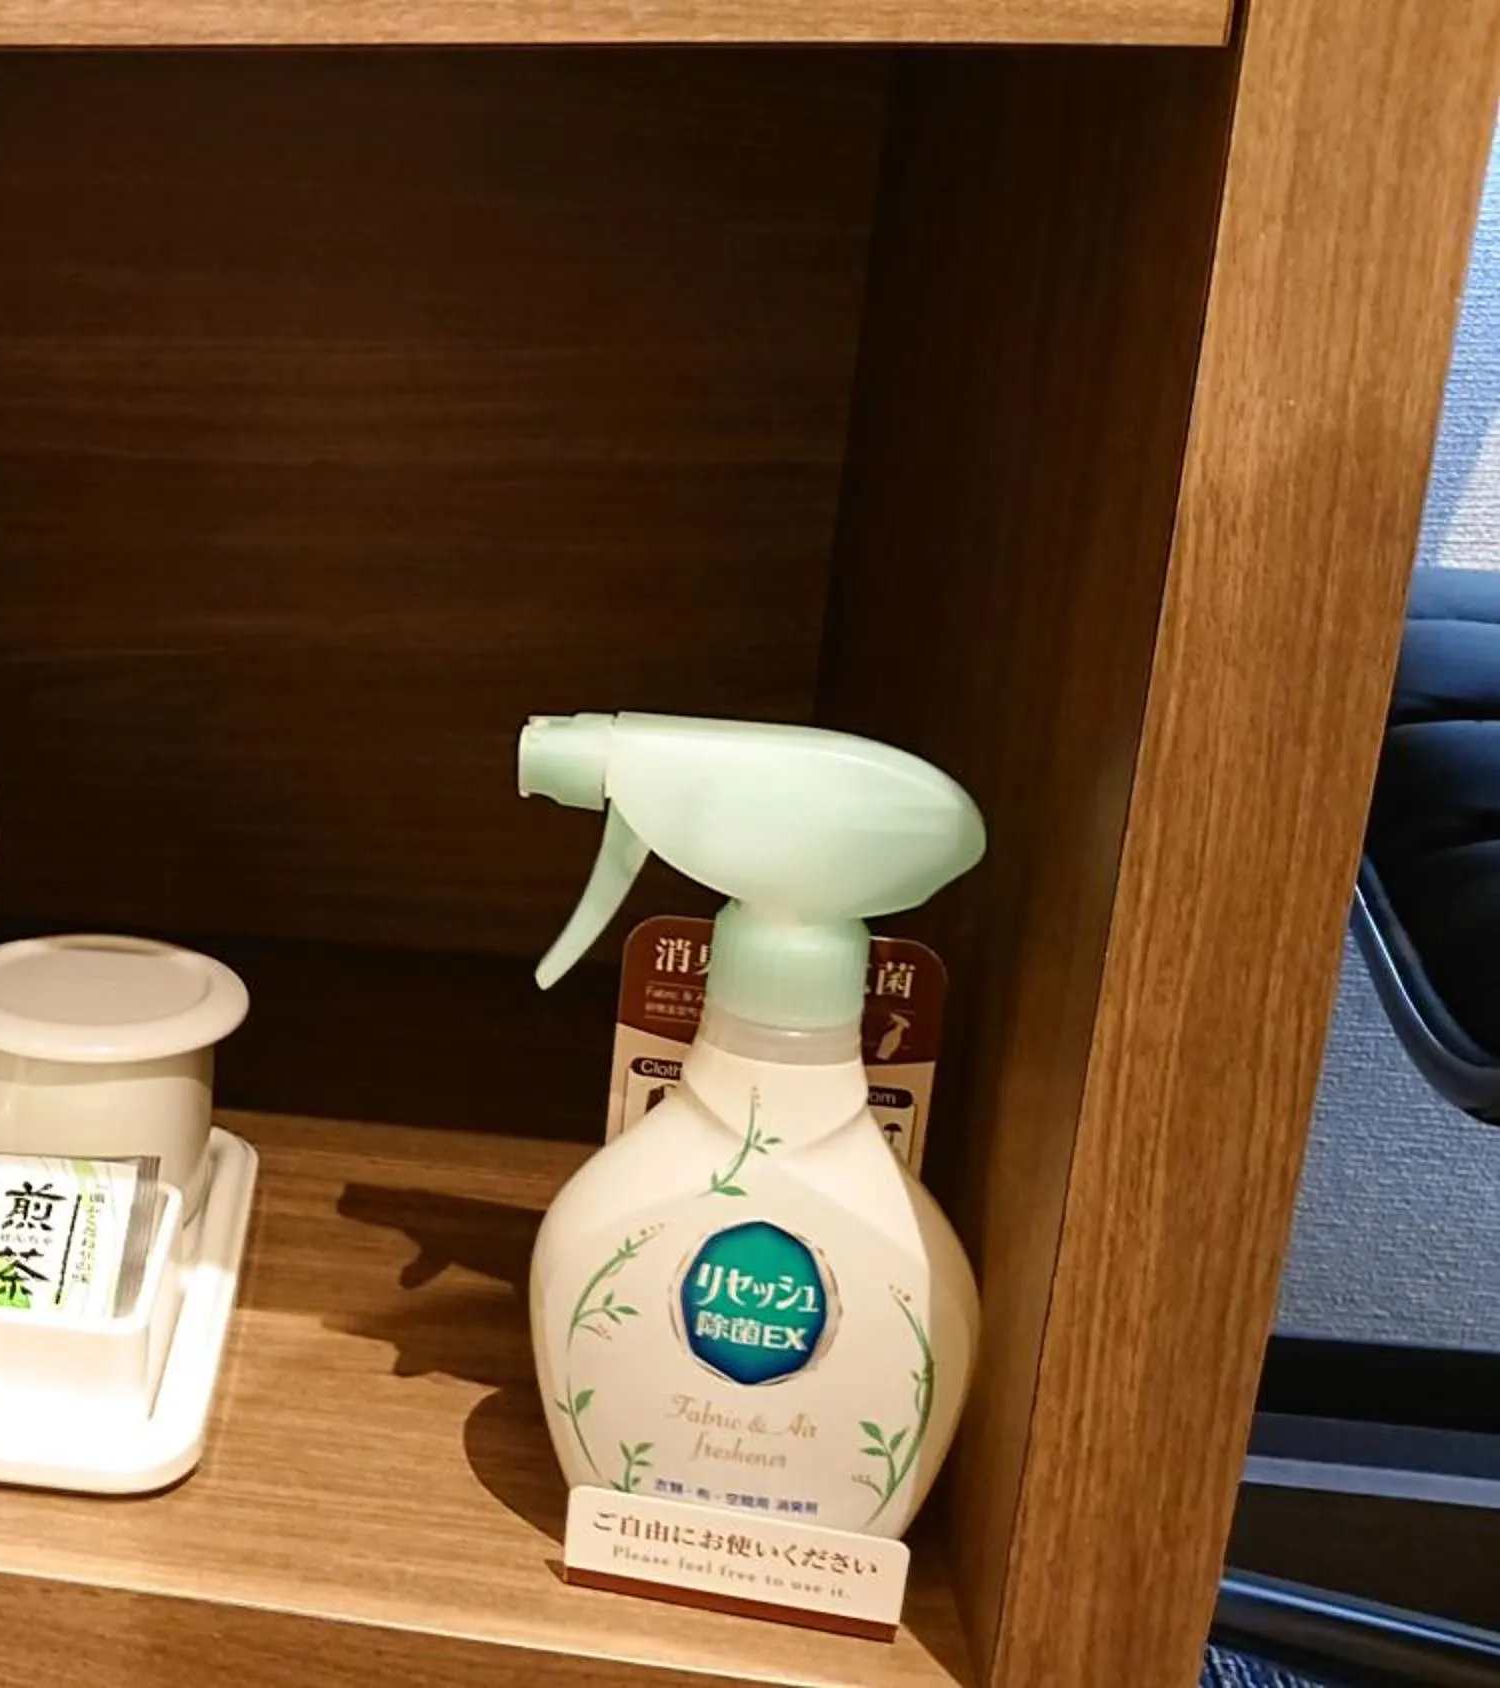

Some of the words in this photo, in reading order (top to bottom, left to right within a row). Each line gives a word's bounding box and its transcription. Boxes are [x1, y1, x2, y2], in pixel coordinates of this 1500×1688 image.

[695, 1262, 820, 1313] リセッシュ
[694, 1311, 809, 1351] 除菌EX
[664, 1392, 742, 1430] Fabric
[747, 1413, 768, 1435] &
[770, 1411, 818, 1439] Air
[688, 1429, 787, 1468] freshener
[592, 1510, 879, 1576] ご自由にお使いください
[611, 1544, 670, 1567] Please
[677, 1555, 713, 1577] feel
[719, 1563, 756, 1584] free
[764, 1570, 785, 1588] to
[790, 1578, 823, 1594] use
[830, 1581, 852, 1599] it.
